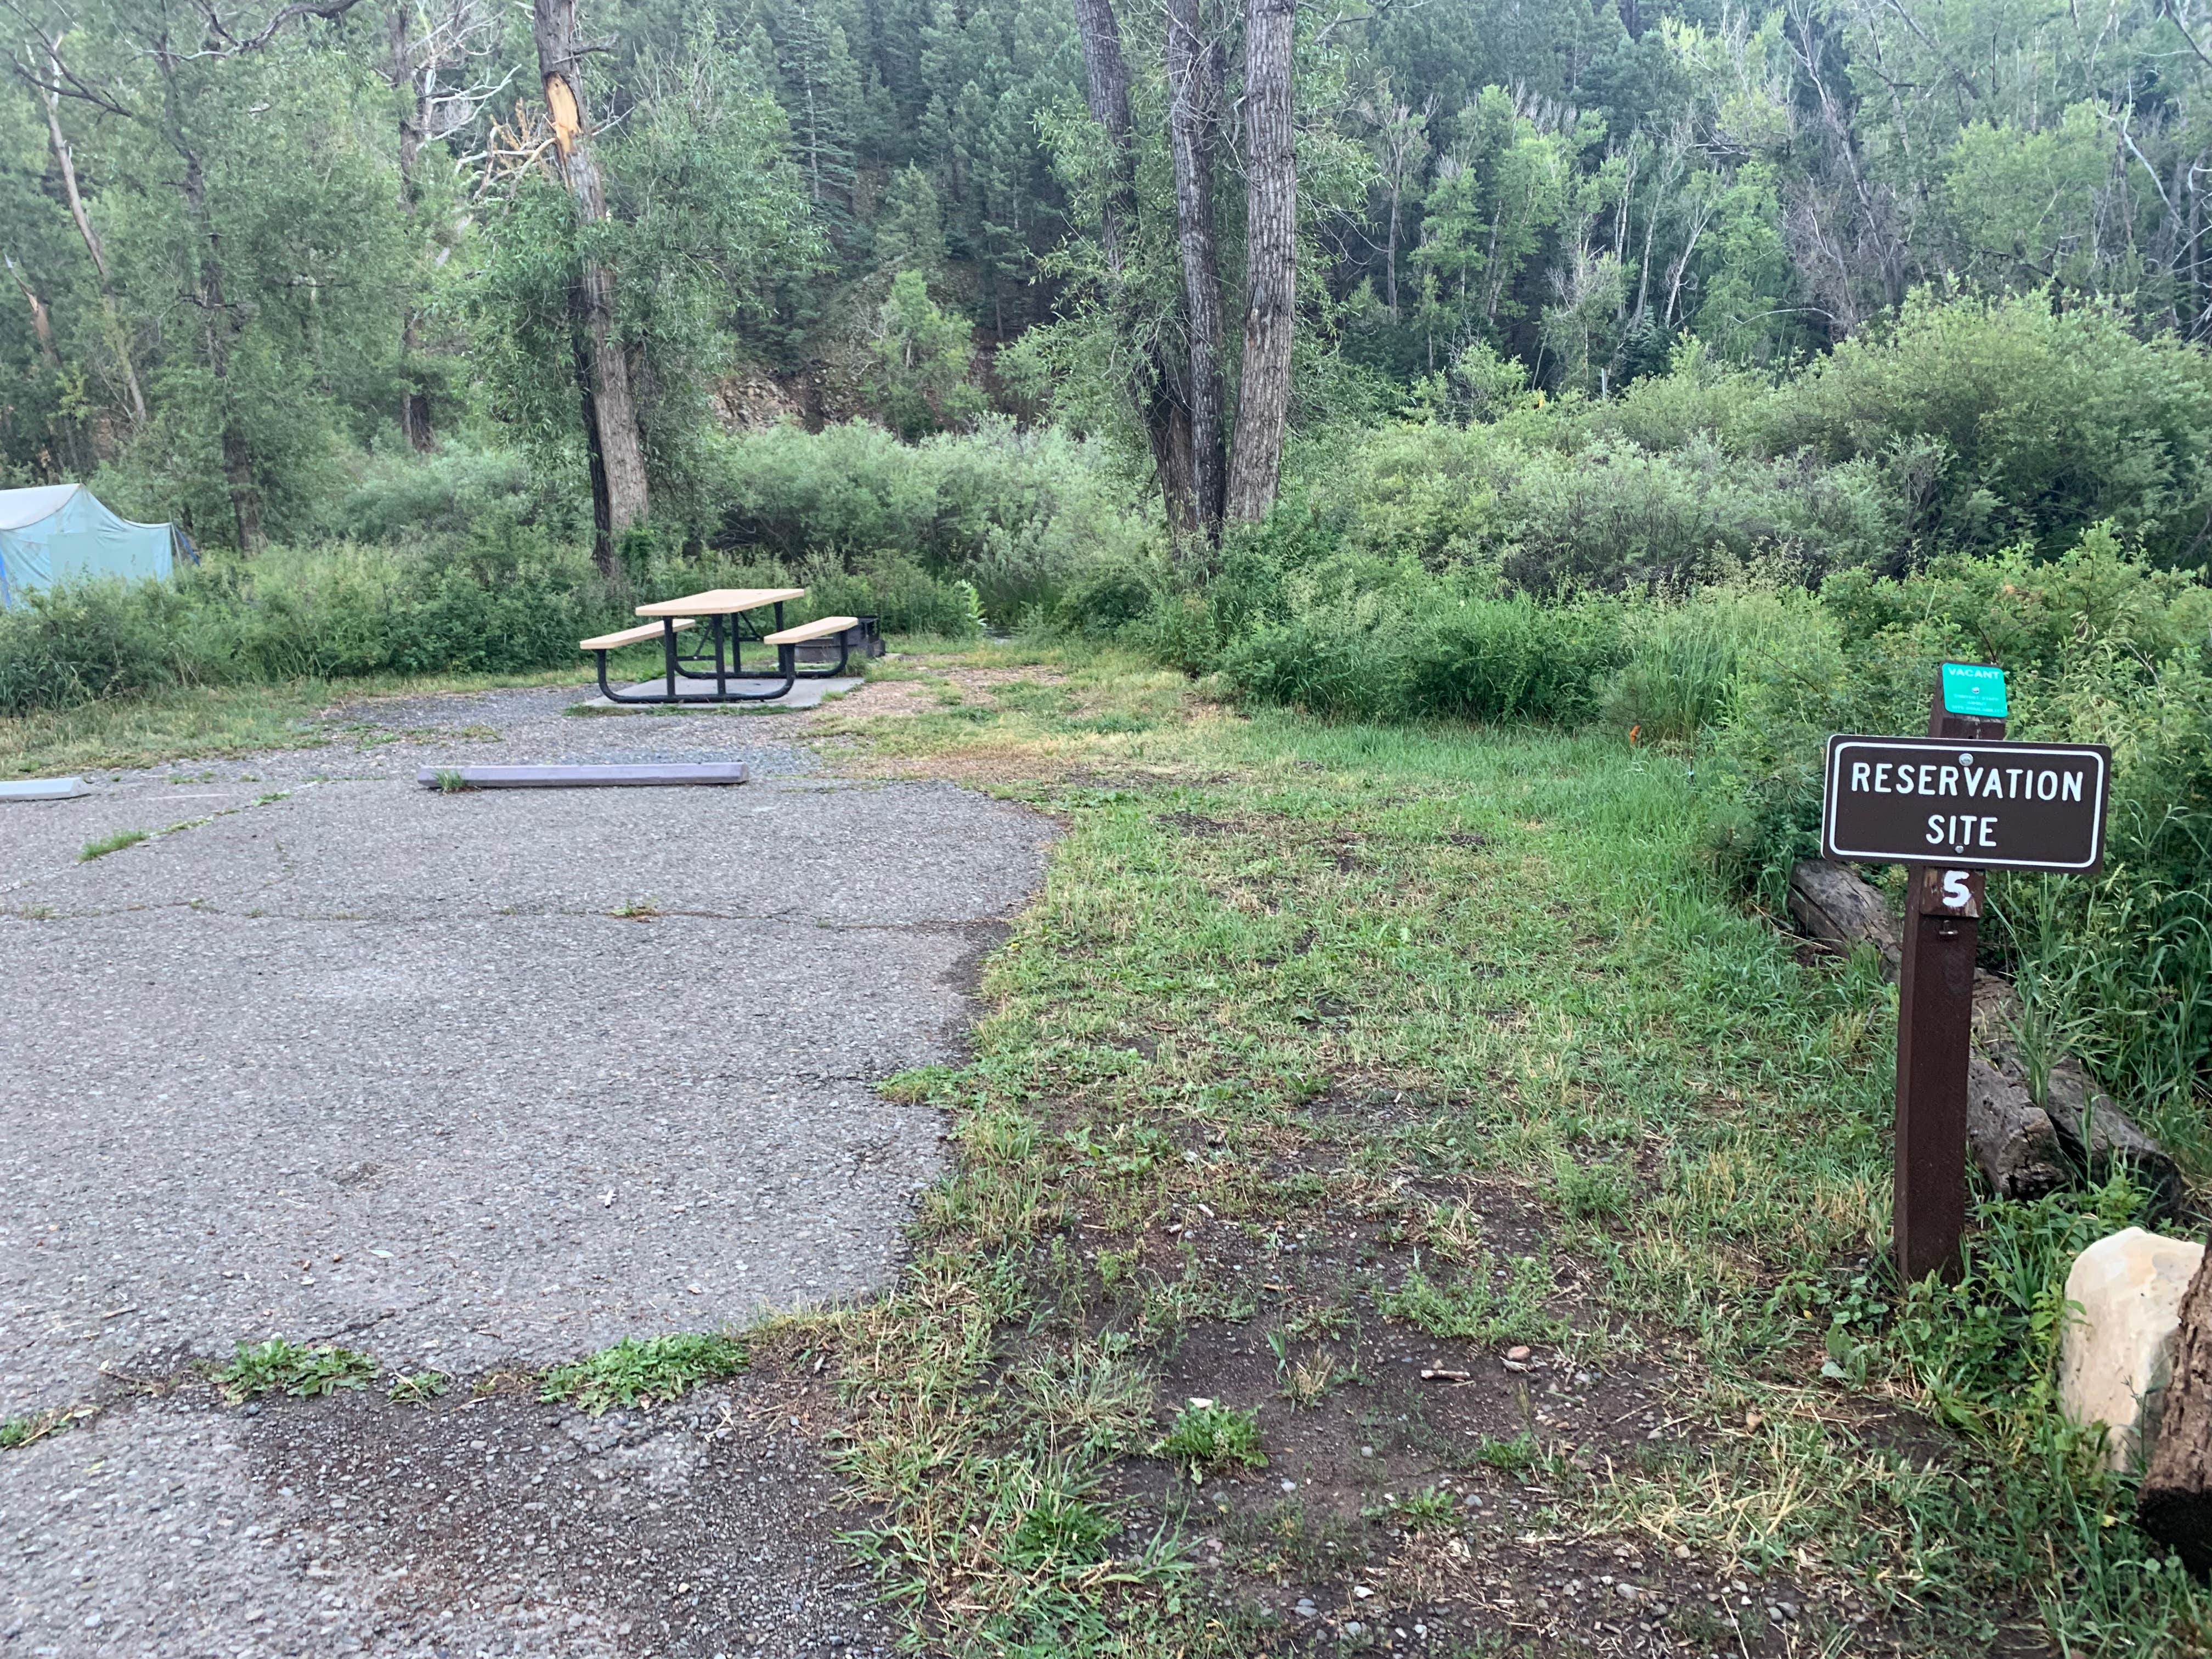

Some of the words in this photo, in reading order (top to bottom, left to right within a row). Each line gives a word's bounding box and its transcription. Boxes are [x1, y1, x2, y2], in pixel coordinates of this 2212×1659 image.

[1948, 667, 2000, 679] VACANT
[1851, 762, 2084, 802] RESERVATION
[1925, 814, 1998, 847] SITE
[1942, 870, 1971, 907] 5
